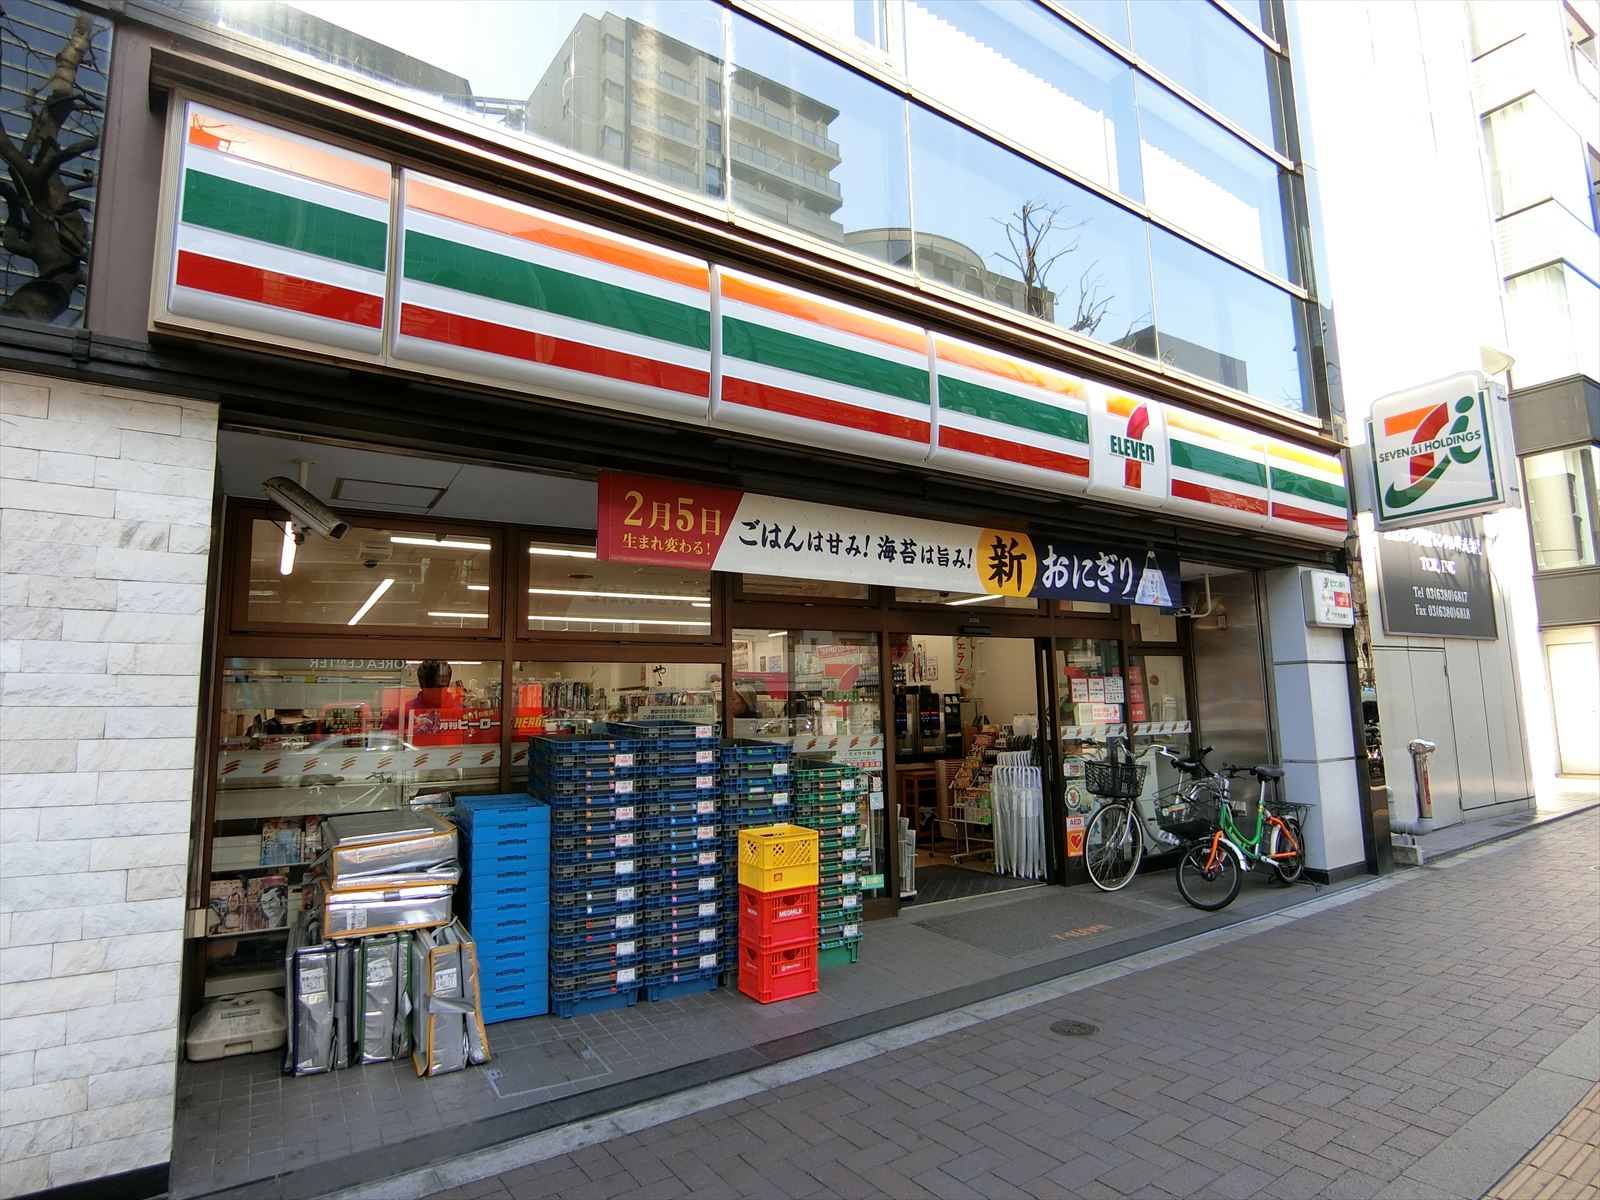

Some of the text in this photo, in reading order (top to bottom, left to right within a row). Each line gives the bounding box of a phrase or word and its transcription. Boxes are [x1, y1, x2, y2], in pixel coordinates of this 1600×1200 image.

[1424, 429, 1482, 452] HOLDINGS
[624, 490, 721, 536] 2月5日
[988, 535, 1027, 592] 新
[1041, 545, 1133, 595] おにぎり
[1413, 586, 1425, 599] Tel
[1415, 604, 1427, 617] Fax
[1069, 818, 1082, 826] AED
